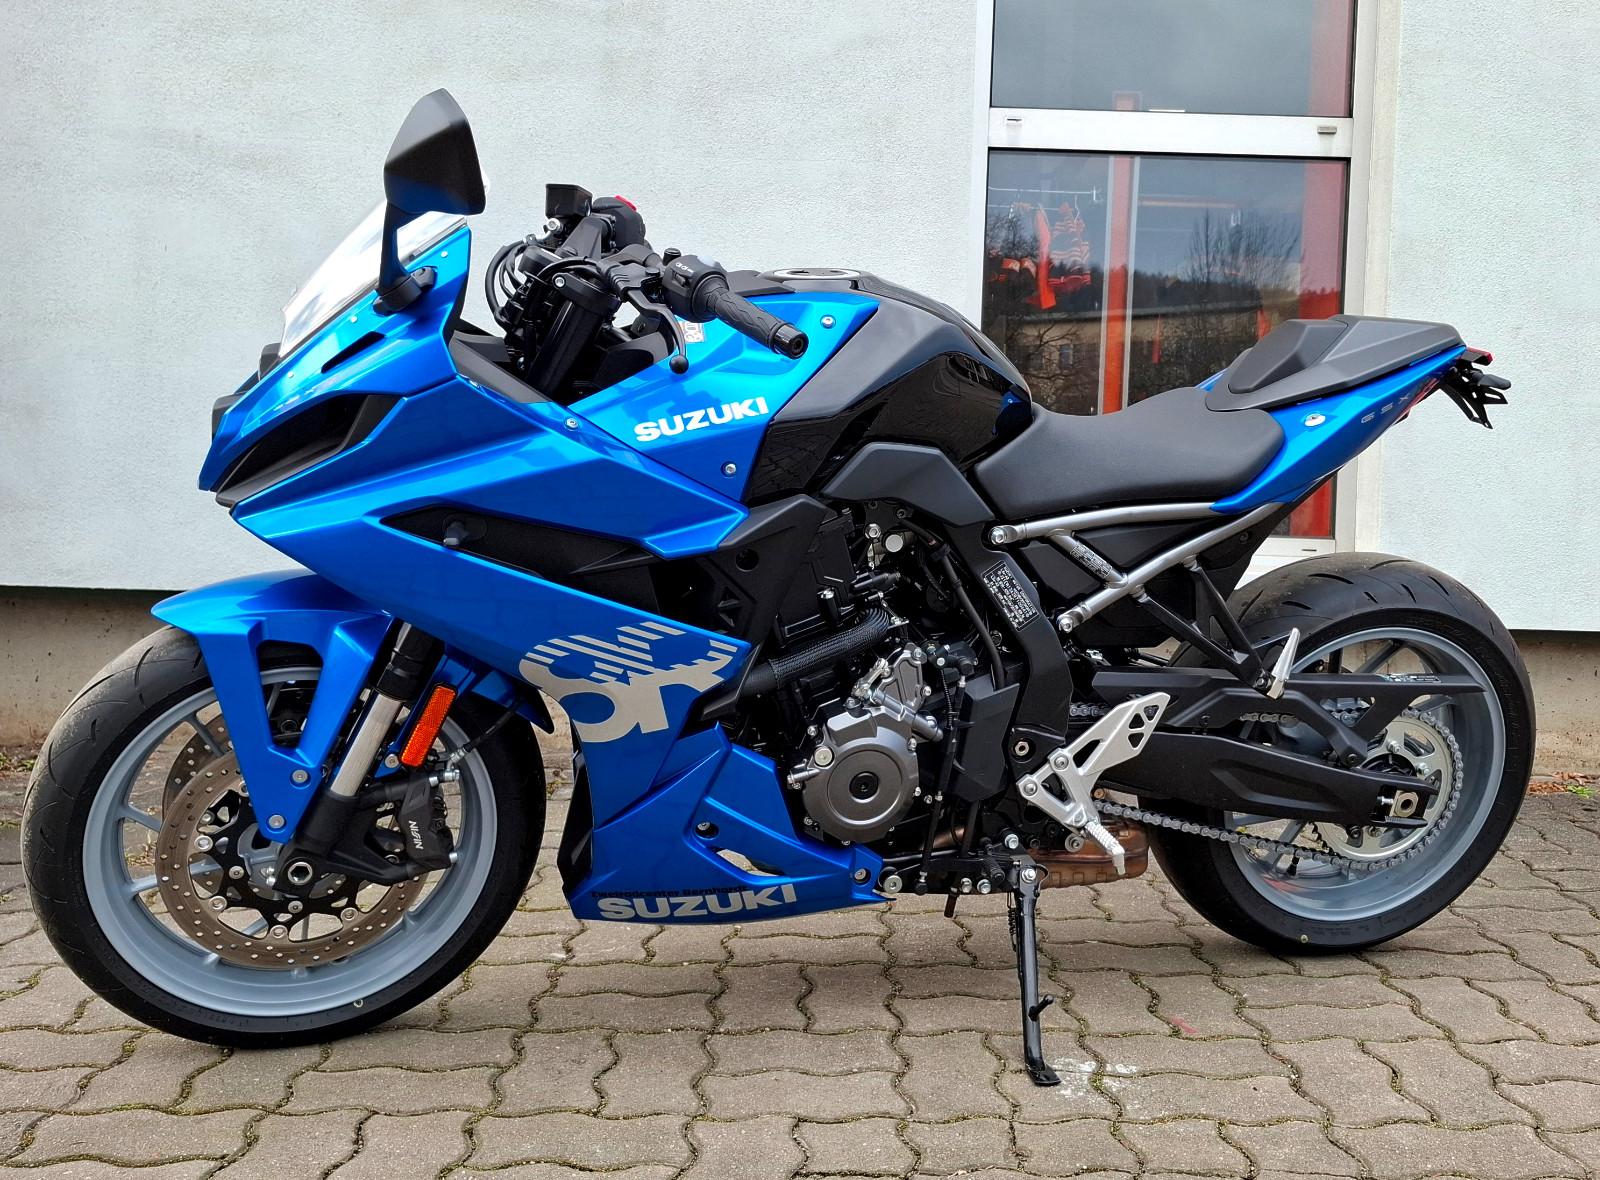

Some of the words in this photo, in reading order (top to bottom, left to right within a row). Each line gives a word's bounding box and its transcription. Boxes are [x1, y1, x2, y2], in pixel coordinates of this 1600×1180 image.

[633, 396, 769, 442] SUZUKI
[408, 820, 424, 850] NISSIN
[597, 883, 797, 919] SUZUKI
